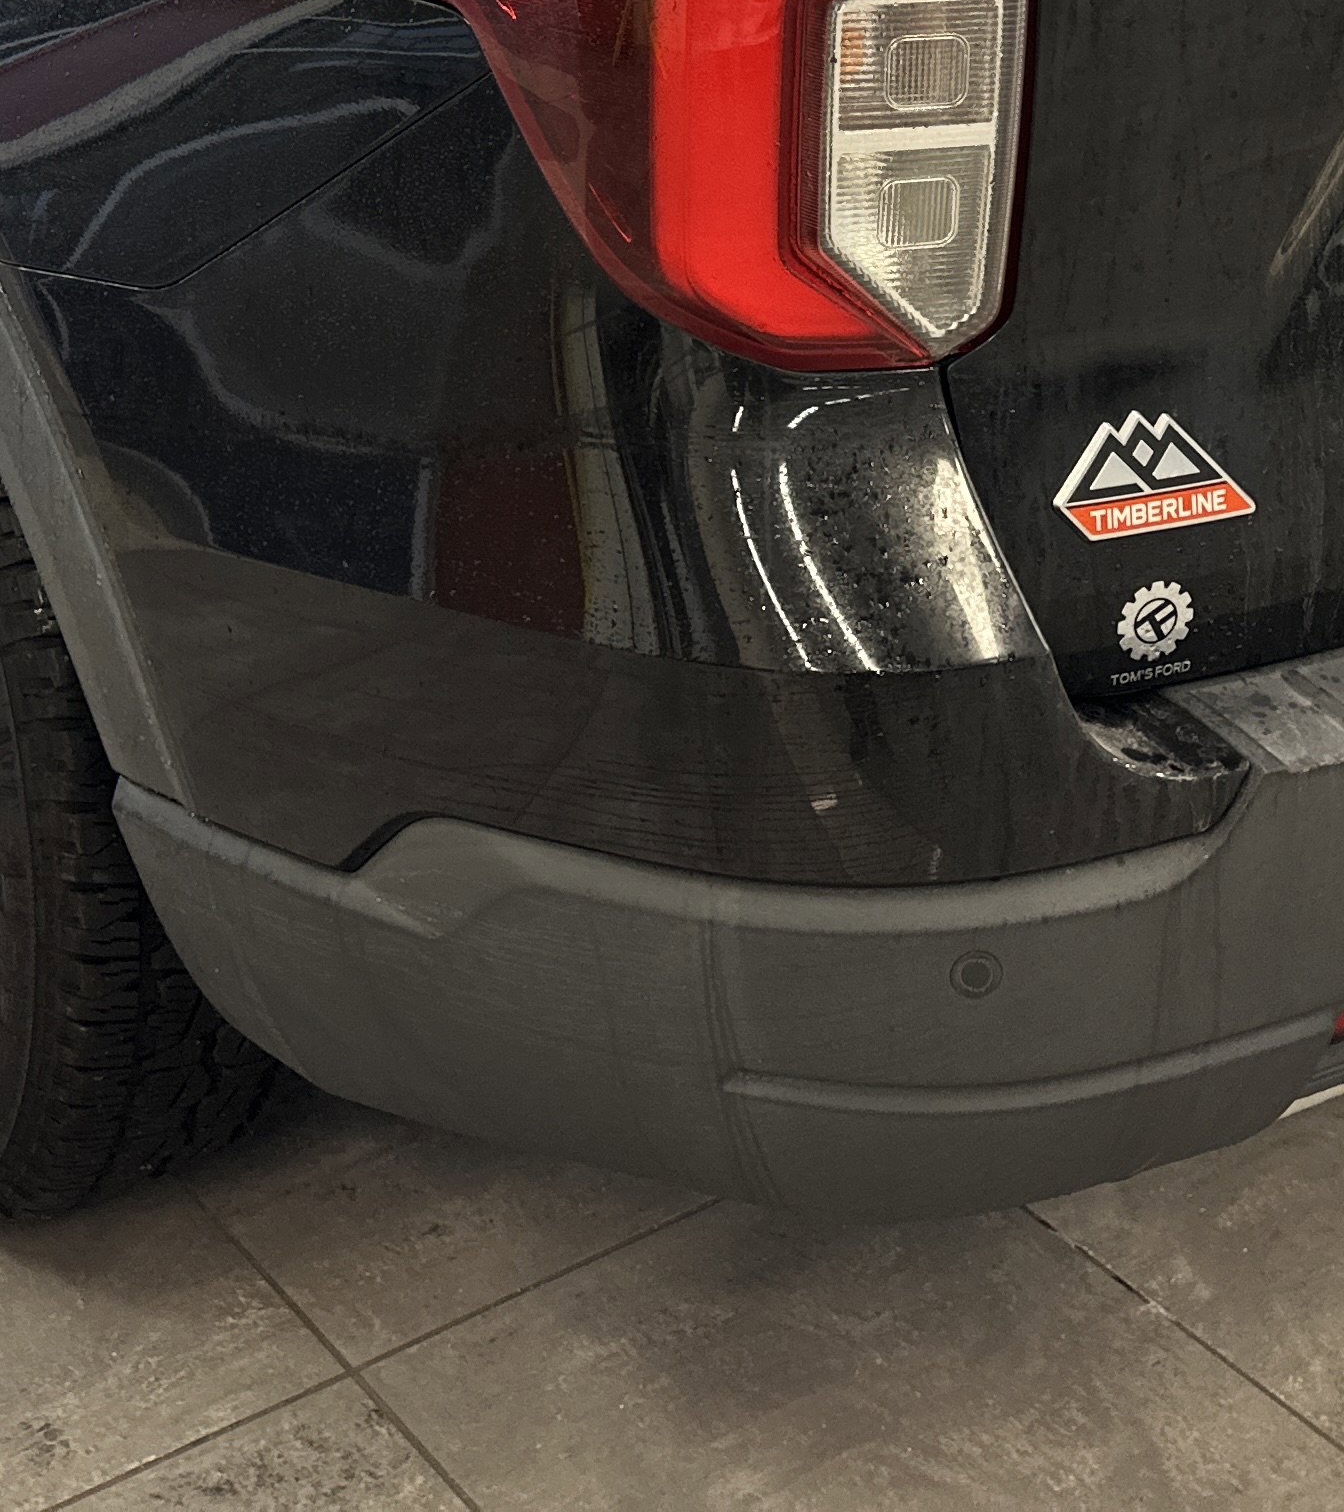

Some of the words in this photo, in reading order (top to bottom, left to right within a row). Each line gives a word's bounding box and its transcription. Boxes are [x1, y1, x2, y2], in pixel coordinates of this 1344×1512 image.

[1089, 488, 1227, 532] TIMBERLINE
[1110, 668, 1154, 686] TOM'S
[1155, 660, 1192, 678] FORD
